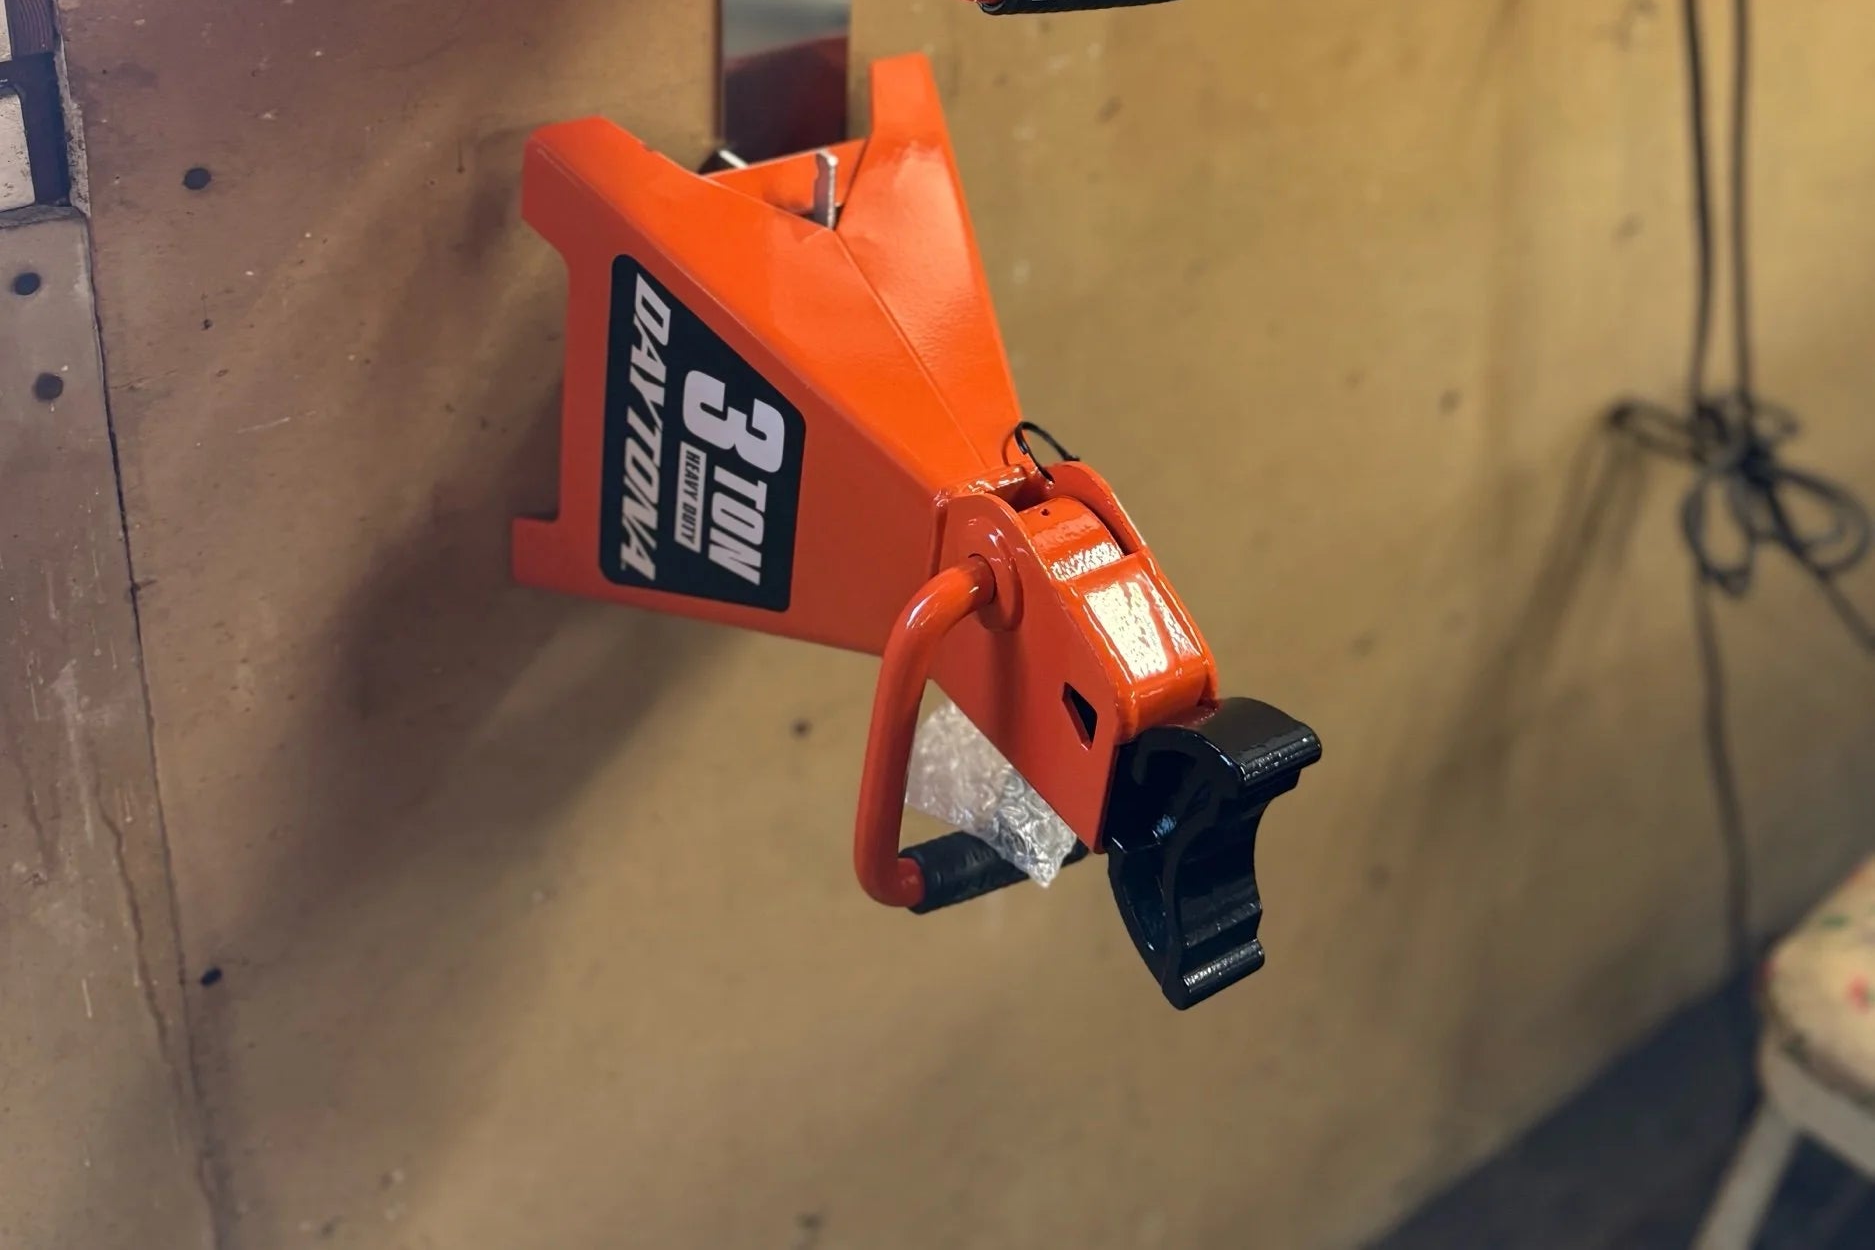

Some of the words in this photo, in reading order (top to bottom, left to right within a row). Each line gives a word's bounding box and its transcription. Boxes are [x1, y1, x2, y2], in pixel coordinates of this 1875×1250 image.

[621, 274, 671, 580] DAYTONA
[683, 370, 785, 473] 3
[682, 503, 698, 544] DUTY
[683, 451, 702, 501] HEAVY
[708, 466, 767, 585] TON
